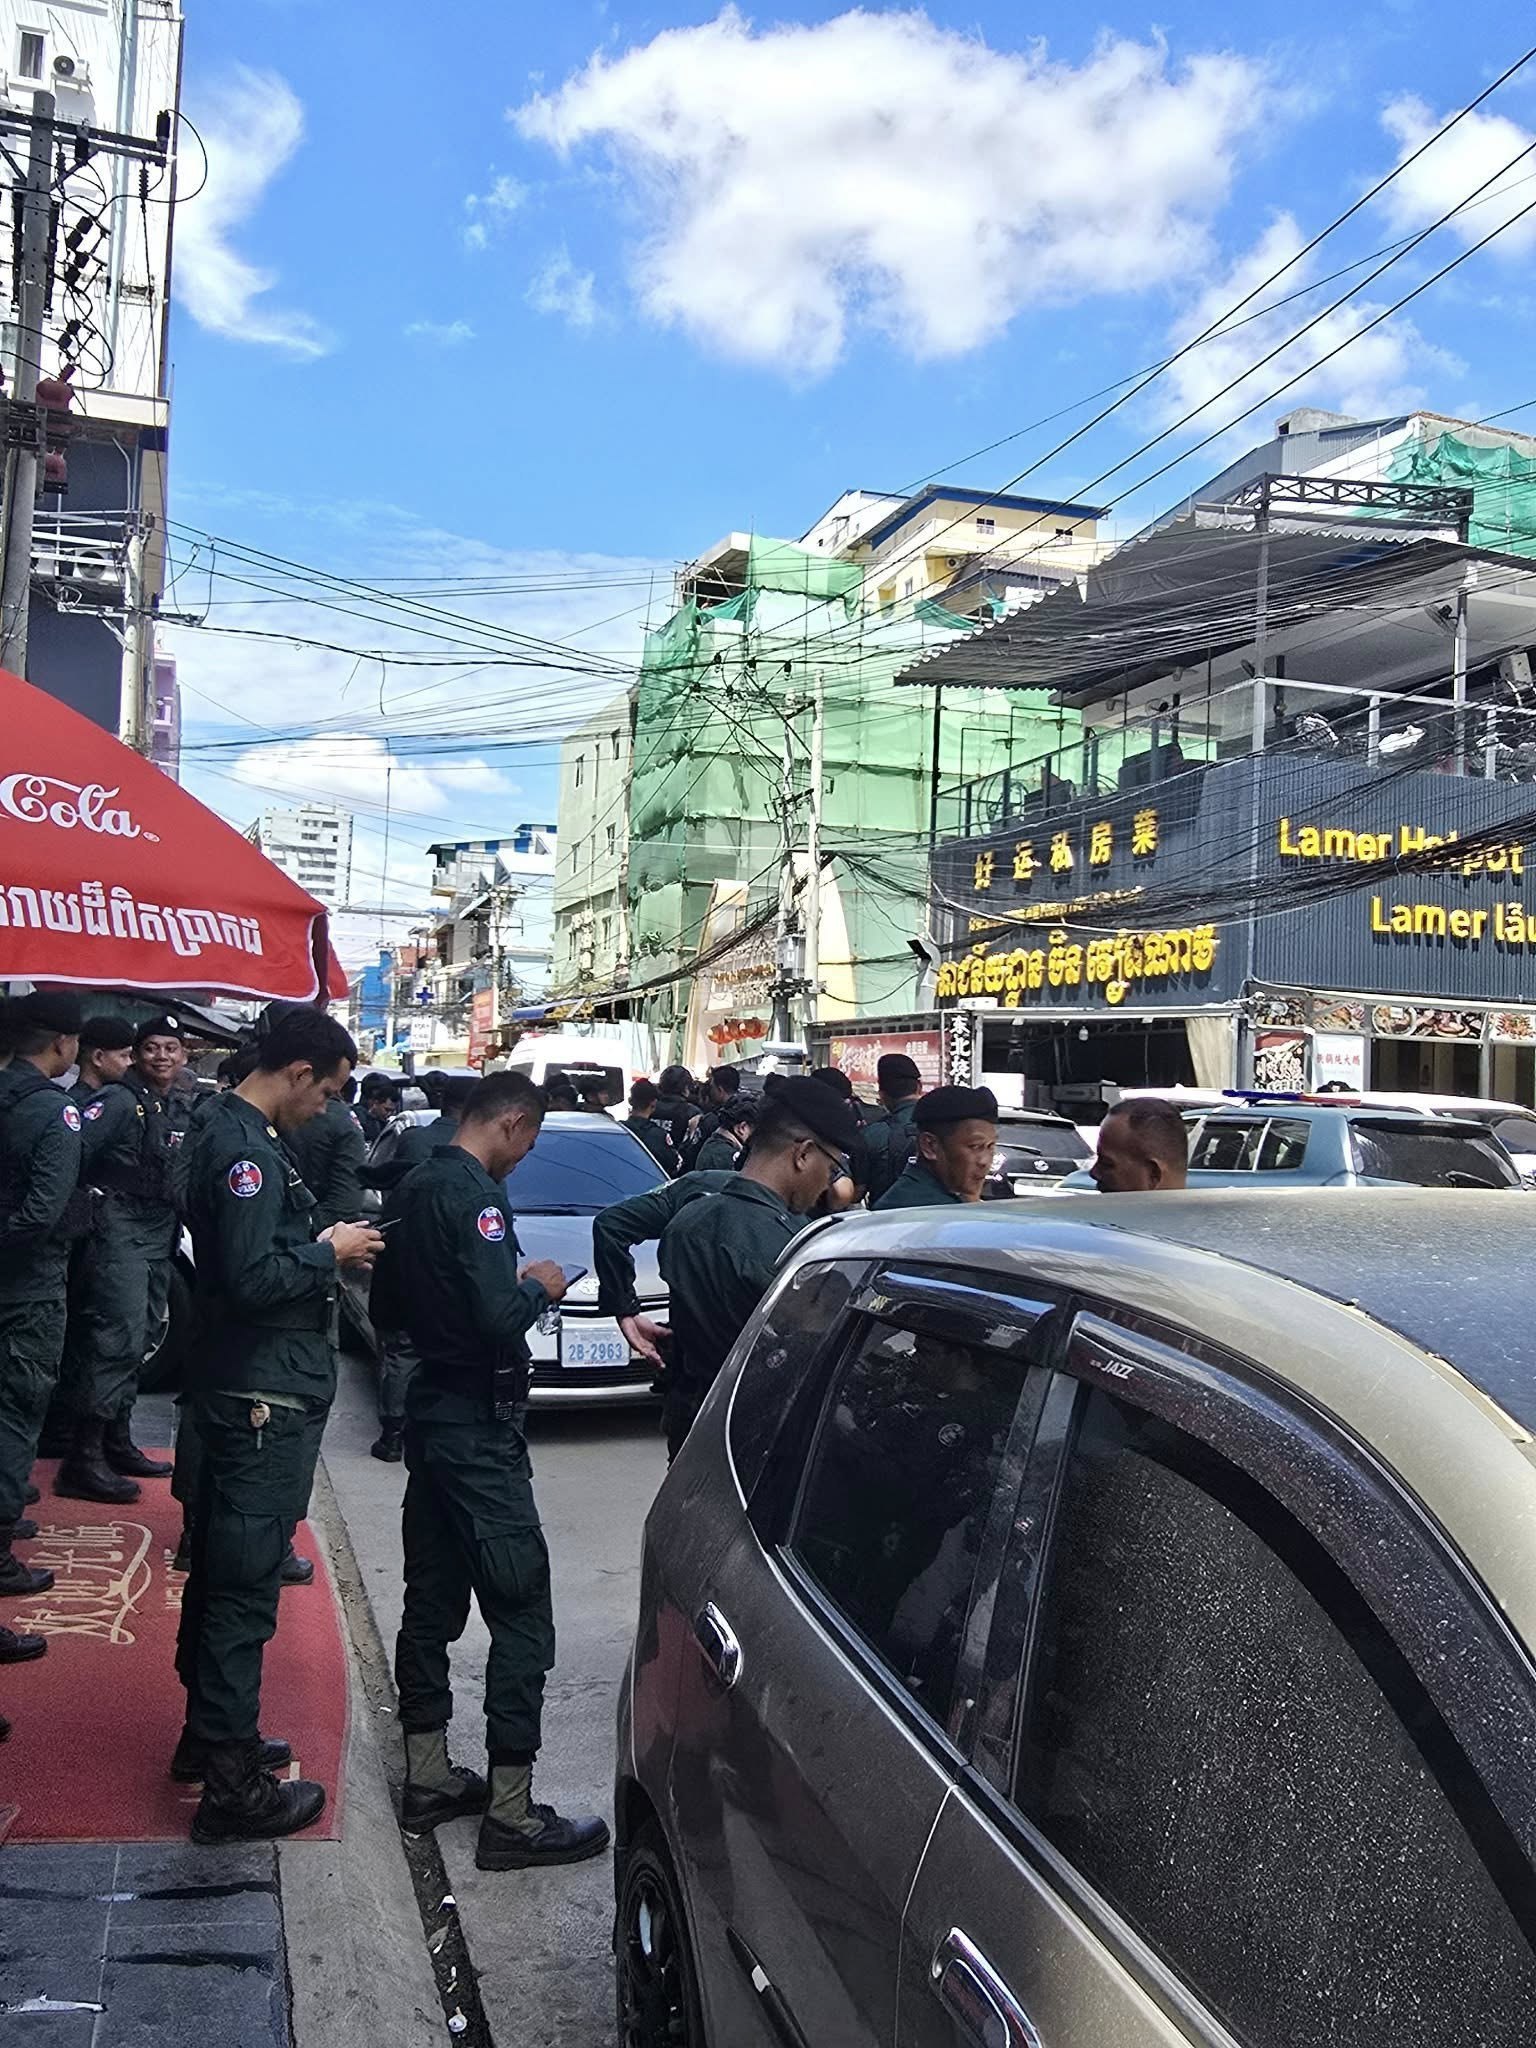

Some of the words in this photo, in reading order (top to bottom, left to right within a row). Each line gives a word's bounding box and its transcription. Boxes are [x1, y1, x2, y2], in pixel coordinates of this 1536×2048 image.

[0, 774, 140, 838] Cola
[974, 808, 1160, 890] 好运私房菜
[1279, 816, 1393, 863] Lamer
[0, 880, 264, 957] រាយដ៏ពិតប្រាកដ
[1370, 895, 1488, 940] Lamer
[568, 1343, 622, 1361] 2B-2963
[1101, 1359, 1135, 1380] JAZZ
[163, 1547, 189, 1610] WELCO
